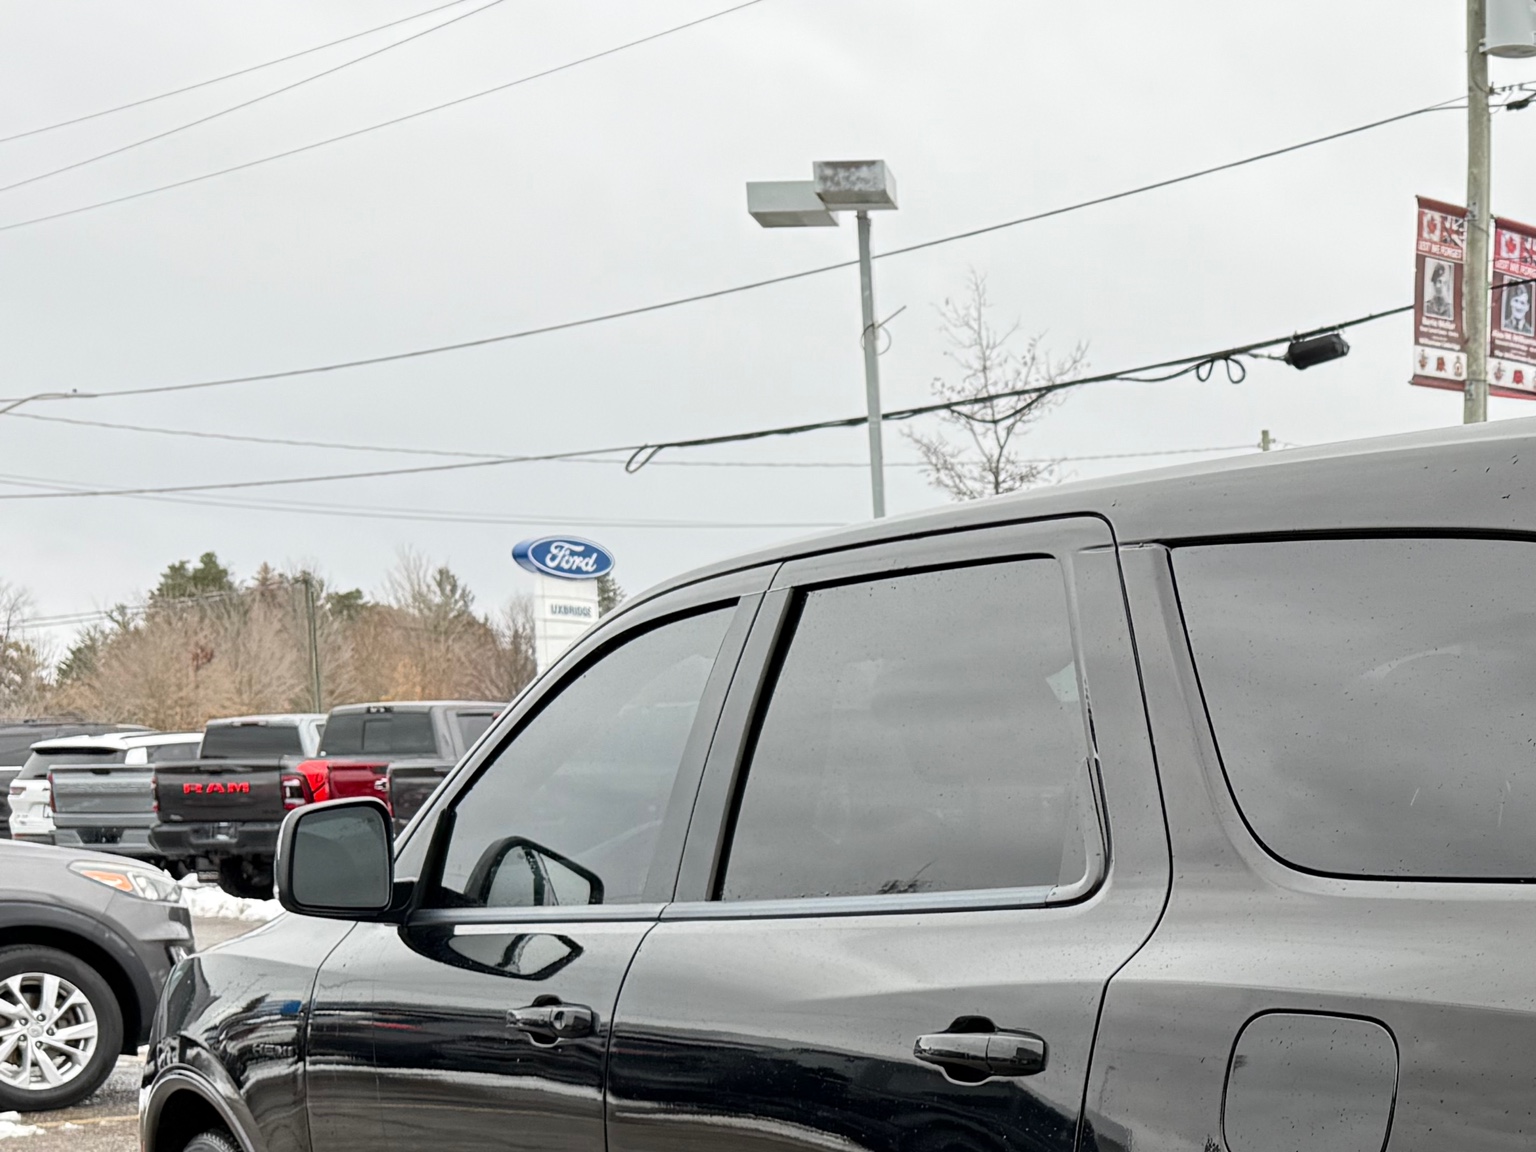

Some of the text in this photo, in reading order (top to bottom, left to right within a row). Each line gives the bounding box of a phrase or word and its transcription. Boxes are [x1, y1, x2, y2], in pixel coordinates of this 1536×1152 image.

[545, 541, 597, 572] Ford
[550, 603, 592, 618] UXBRIDGE
[183, 782, 249, 794] RAM
